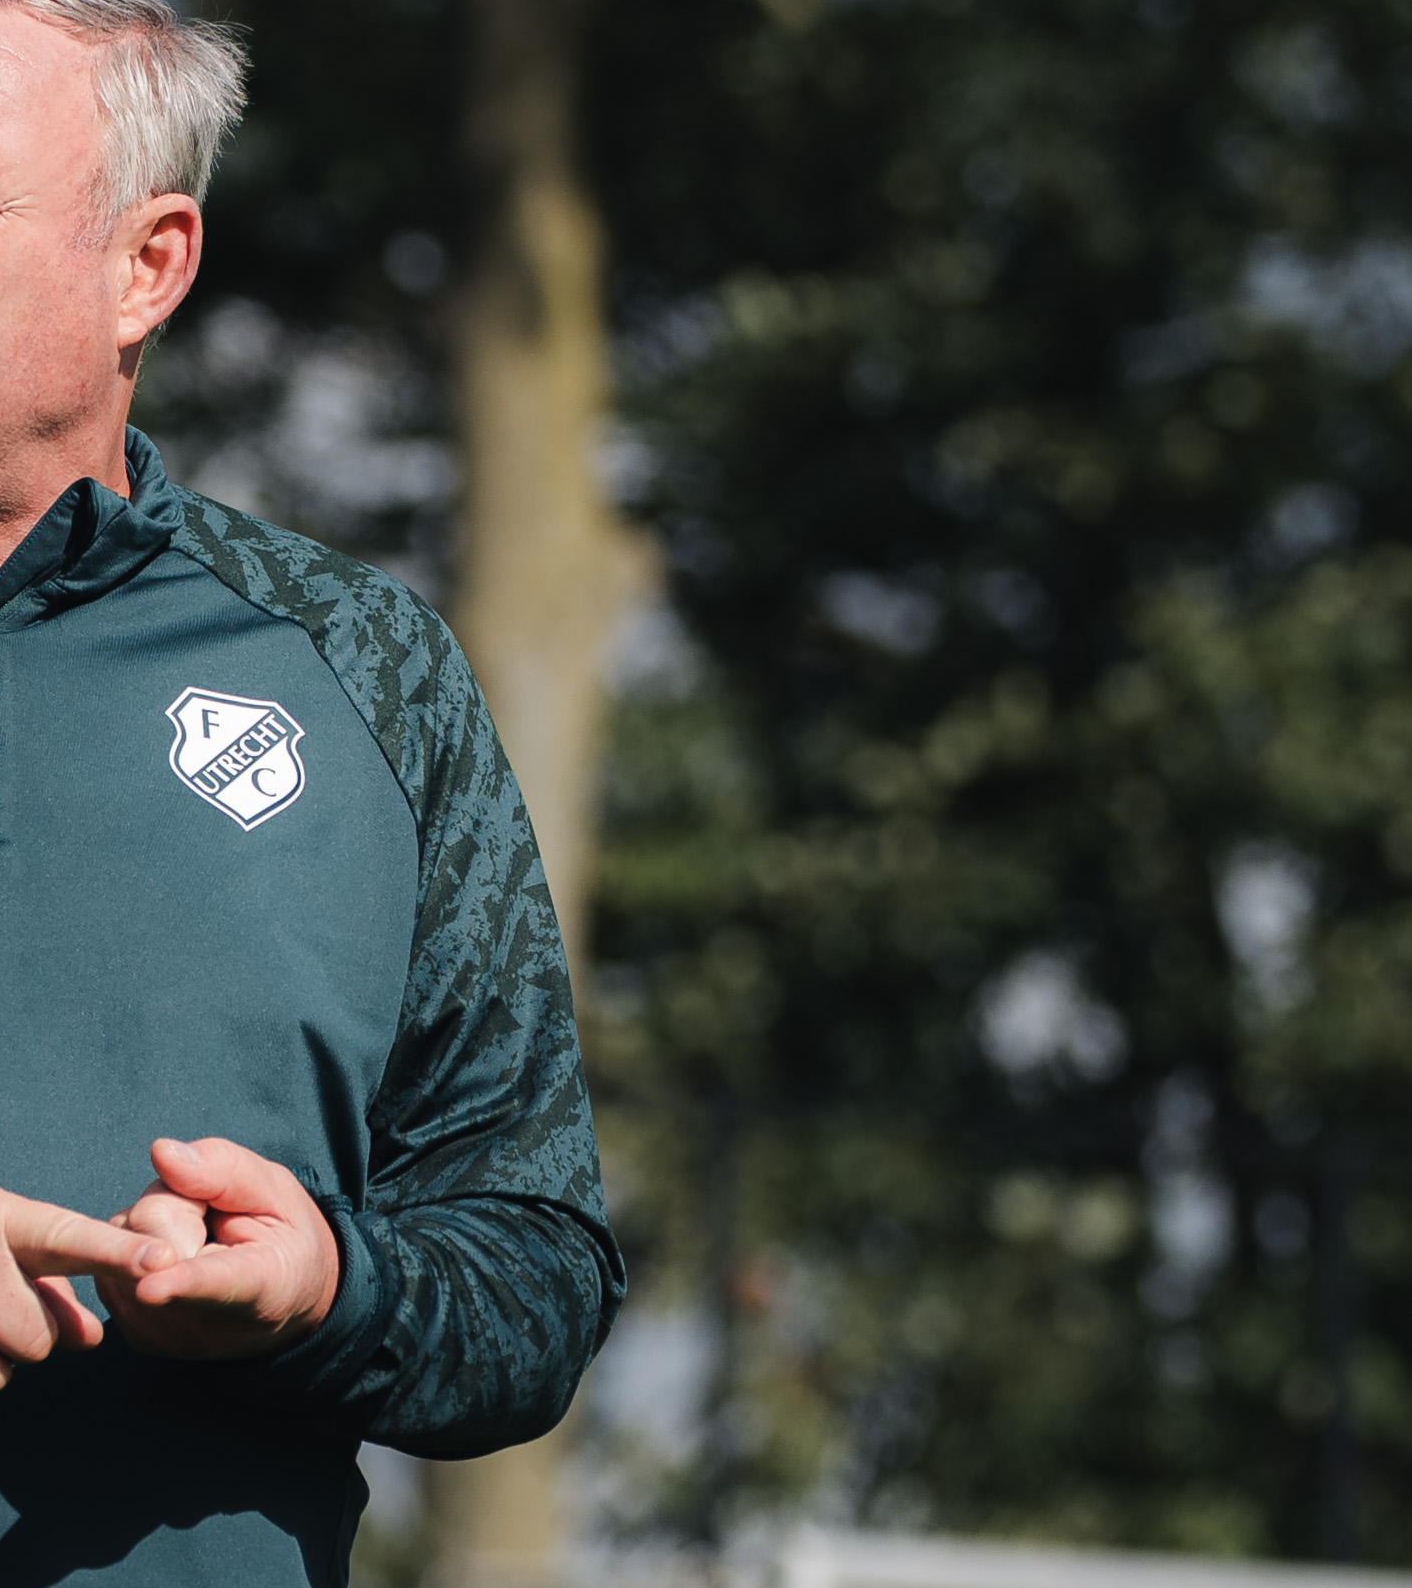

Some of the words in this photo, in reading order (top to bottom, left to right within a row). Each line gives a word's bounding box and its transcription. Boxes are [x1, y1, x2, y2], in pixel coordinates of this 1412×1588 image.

[201, 708, 220, 739] F
[192, 714, 288, 794] UTRECHT
[251, 767, 278, 797] C
